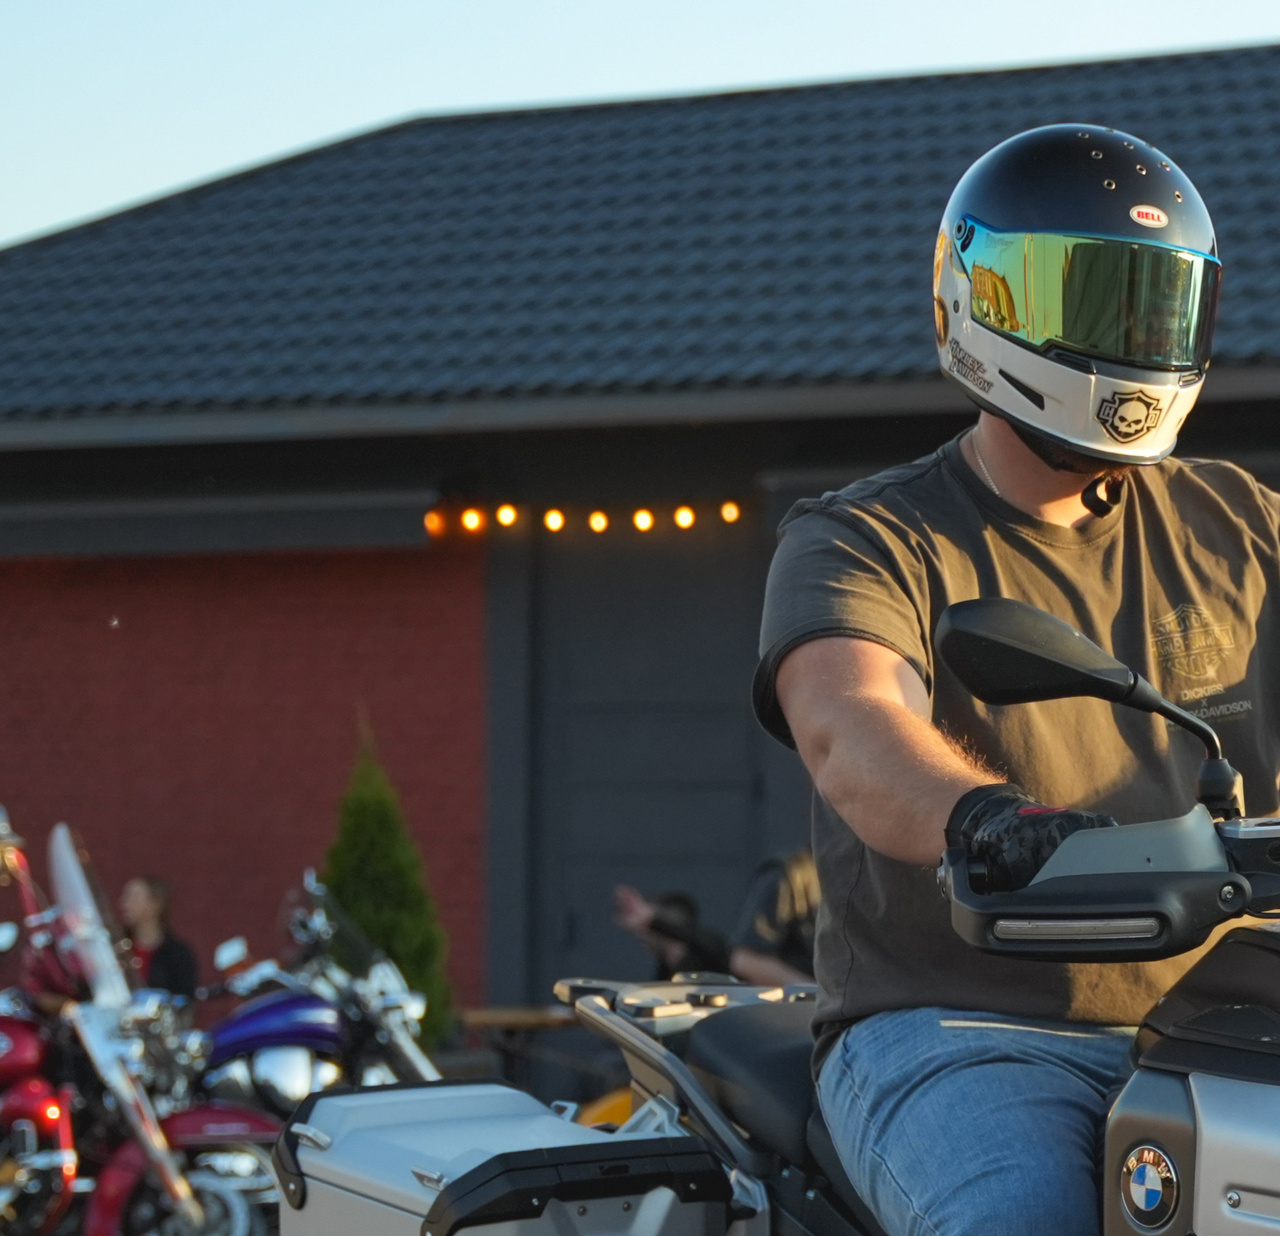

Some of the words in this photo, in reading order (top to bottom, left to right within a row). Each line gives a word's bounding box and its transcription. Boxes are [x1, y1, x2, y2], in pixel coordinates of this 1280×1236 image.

[1136, 210, 1162, 222] BELL
[949, 358, 994, 393] DAVIDSON
[1181, 683, 1225, 701] DICKIES
[1127, 1149, 1173, 1178] BMW
